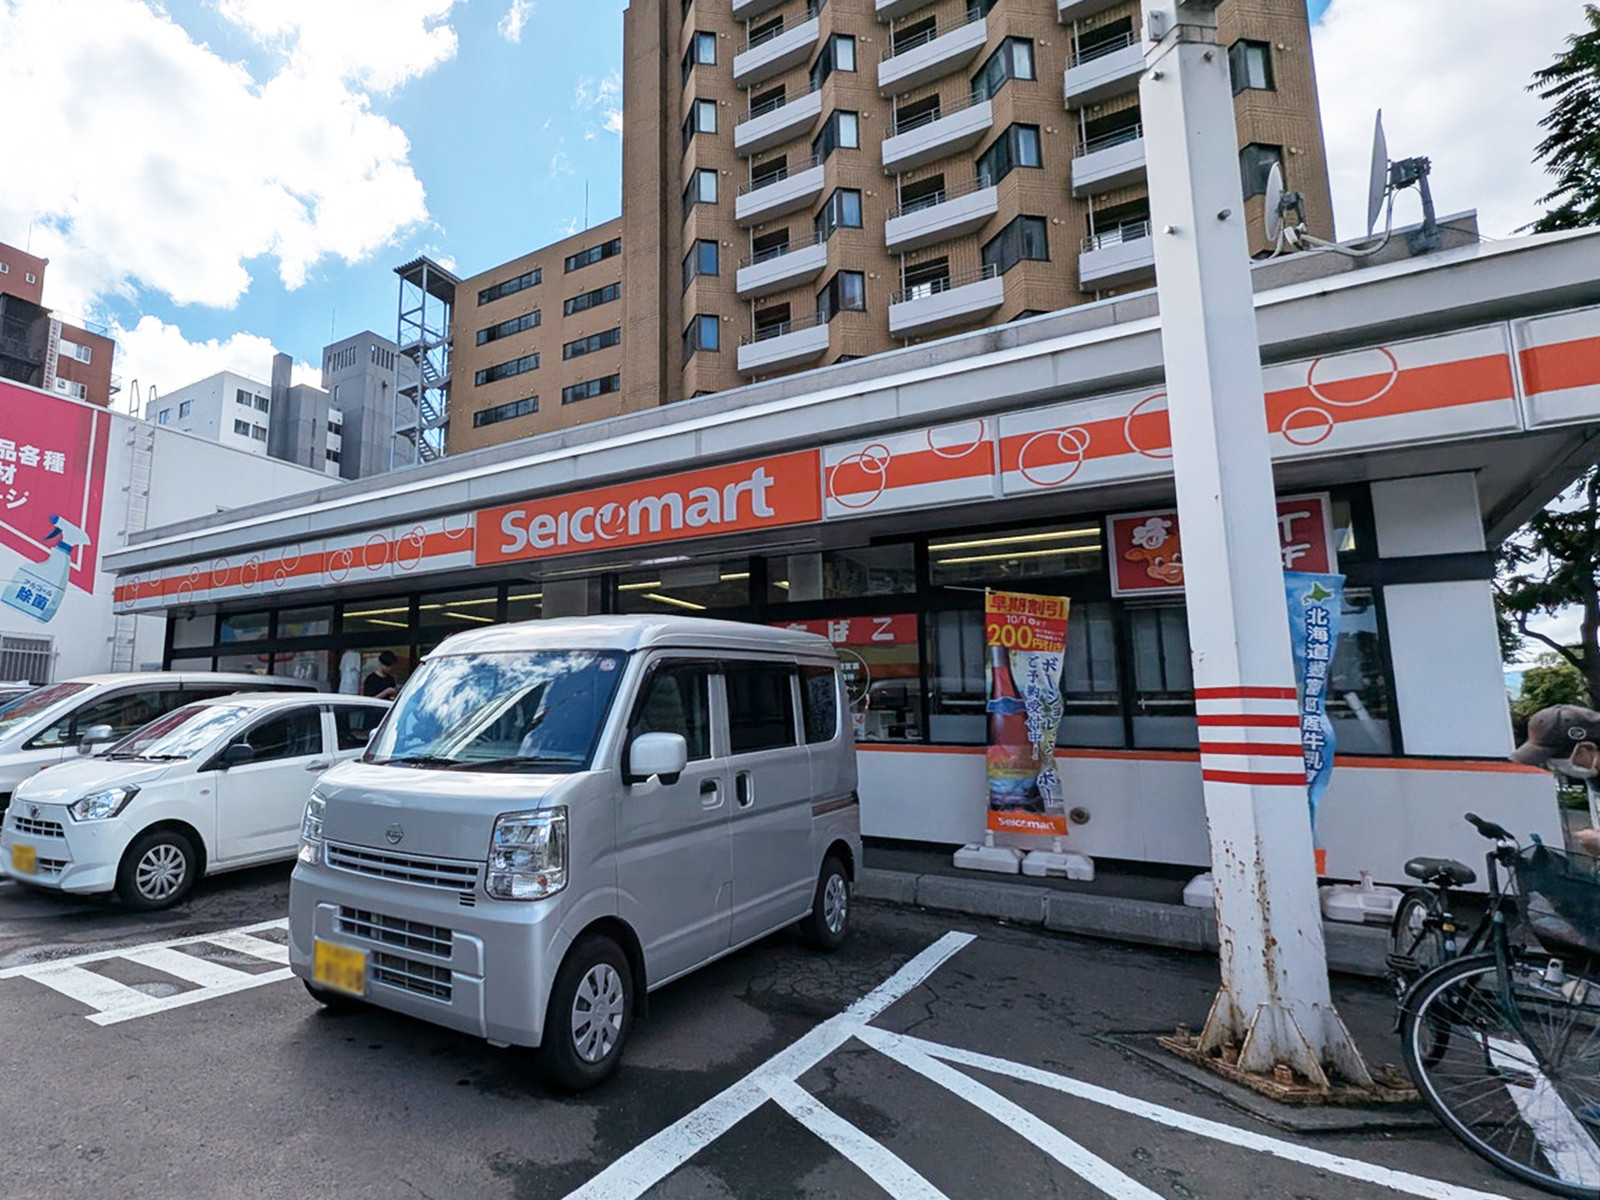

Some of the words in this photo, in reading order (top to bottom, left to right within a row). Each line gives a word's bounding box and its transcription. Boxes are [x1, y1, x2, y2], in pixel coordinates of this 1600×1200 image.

[0, 438, 65, 474] 品各種
[500, 466, 774, 554] Seicomart
[15, 585, 49, 611] 除菌
[991, 595, 1064, 617] 早期割引
